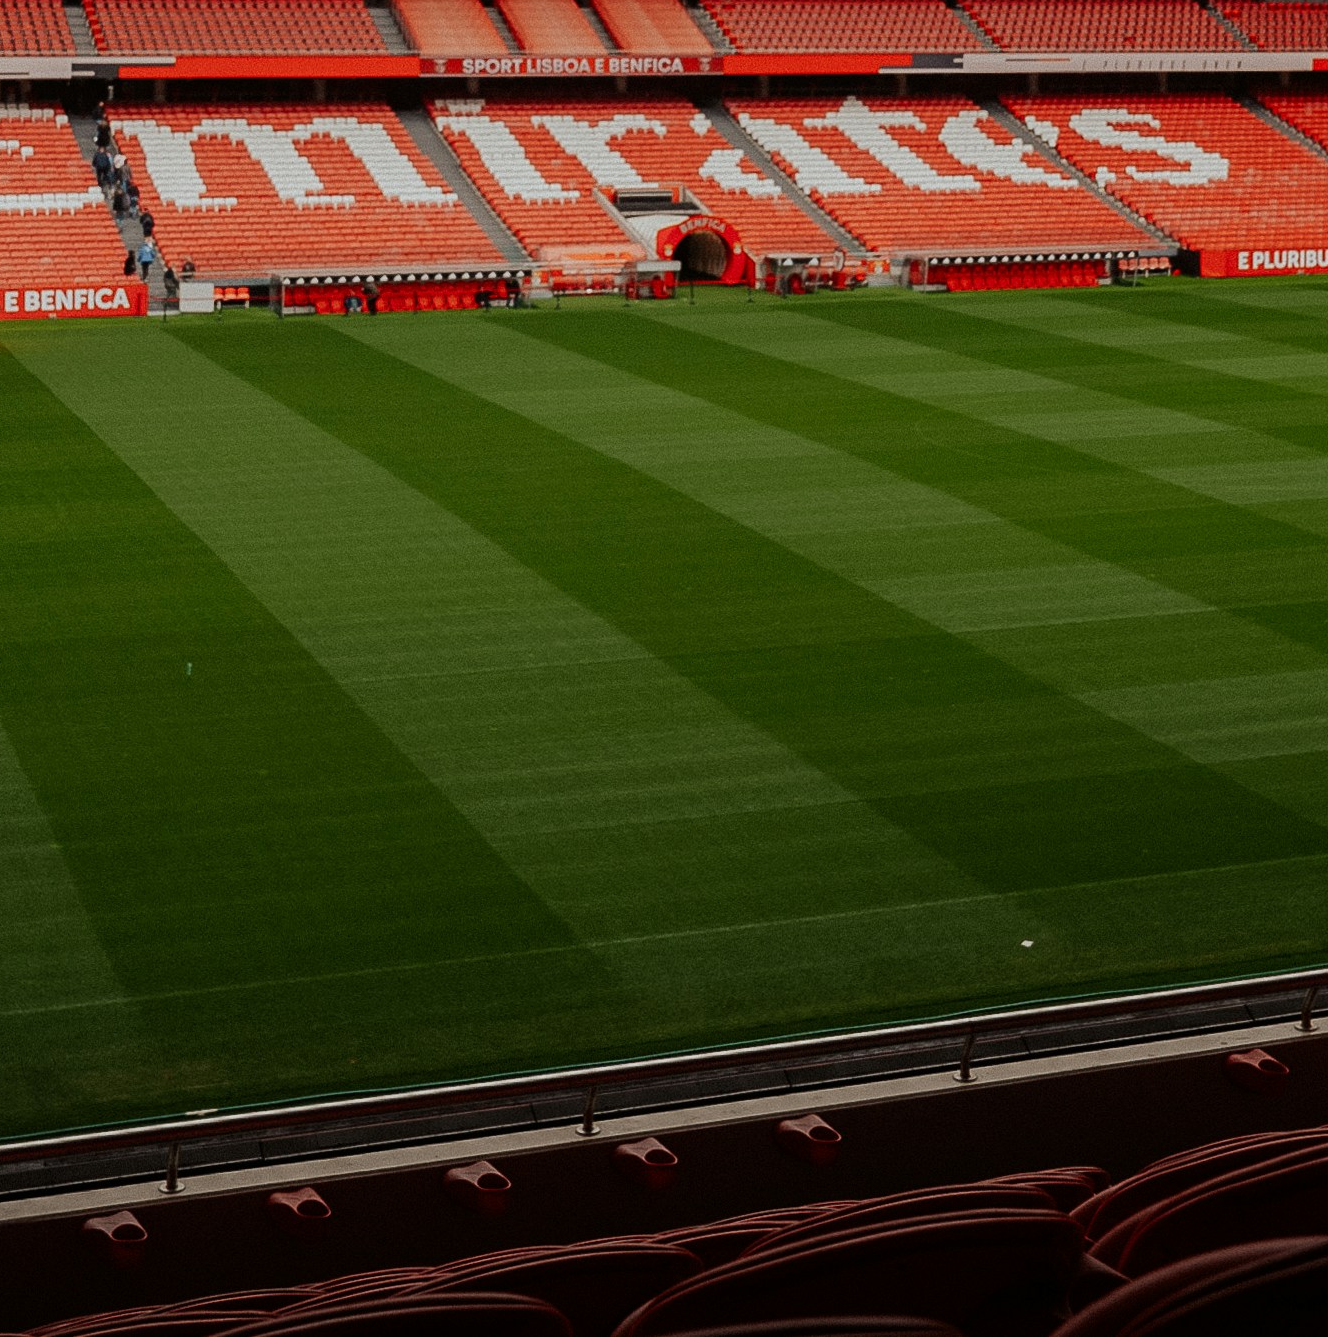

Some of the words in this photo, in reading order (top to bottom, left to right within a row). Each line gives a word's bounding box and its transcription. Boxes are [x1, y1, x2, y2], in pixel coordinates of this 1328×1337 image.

[462, 58, 524, 74] SPORT
[526, 58, 591, 74] LISBOA
[594, 58, 605, 73] E
[608, 57, 684, 73] BENFICA
[679, 217, 727, 234] BENFICA
[1237, 250, 1250, 270] E
[4, 290, 20, 314] E
[24, 287, 131, 312] BENFICA
